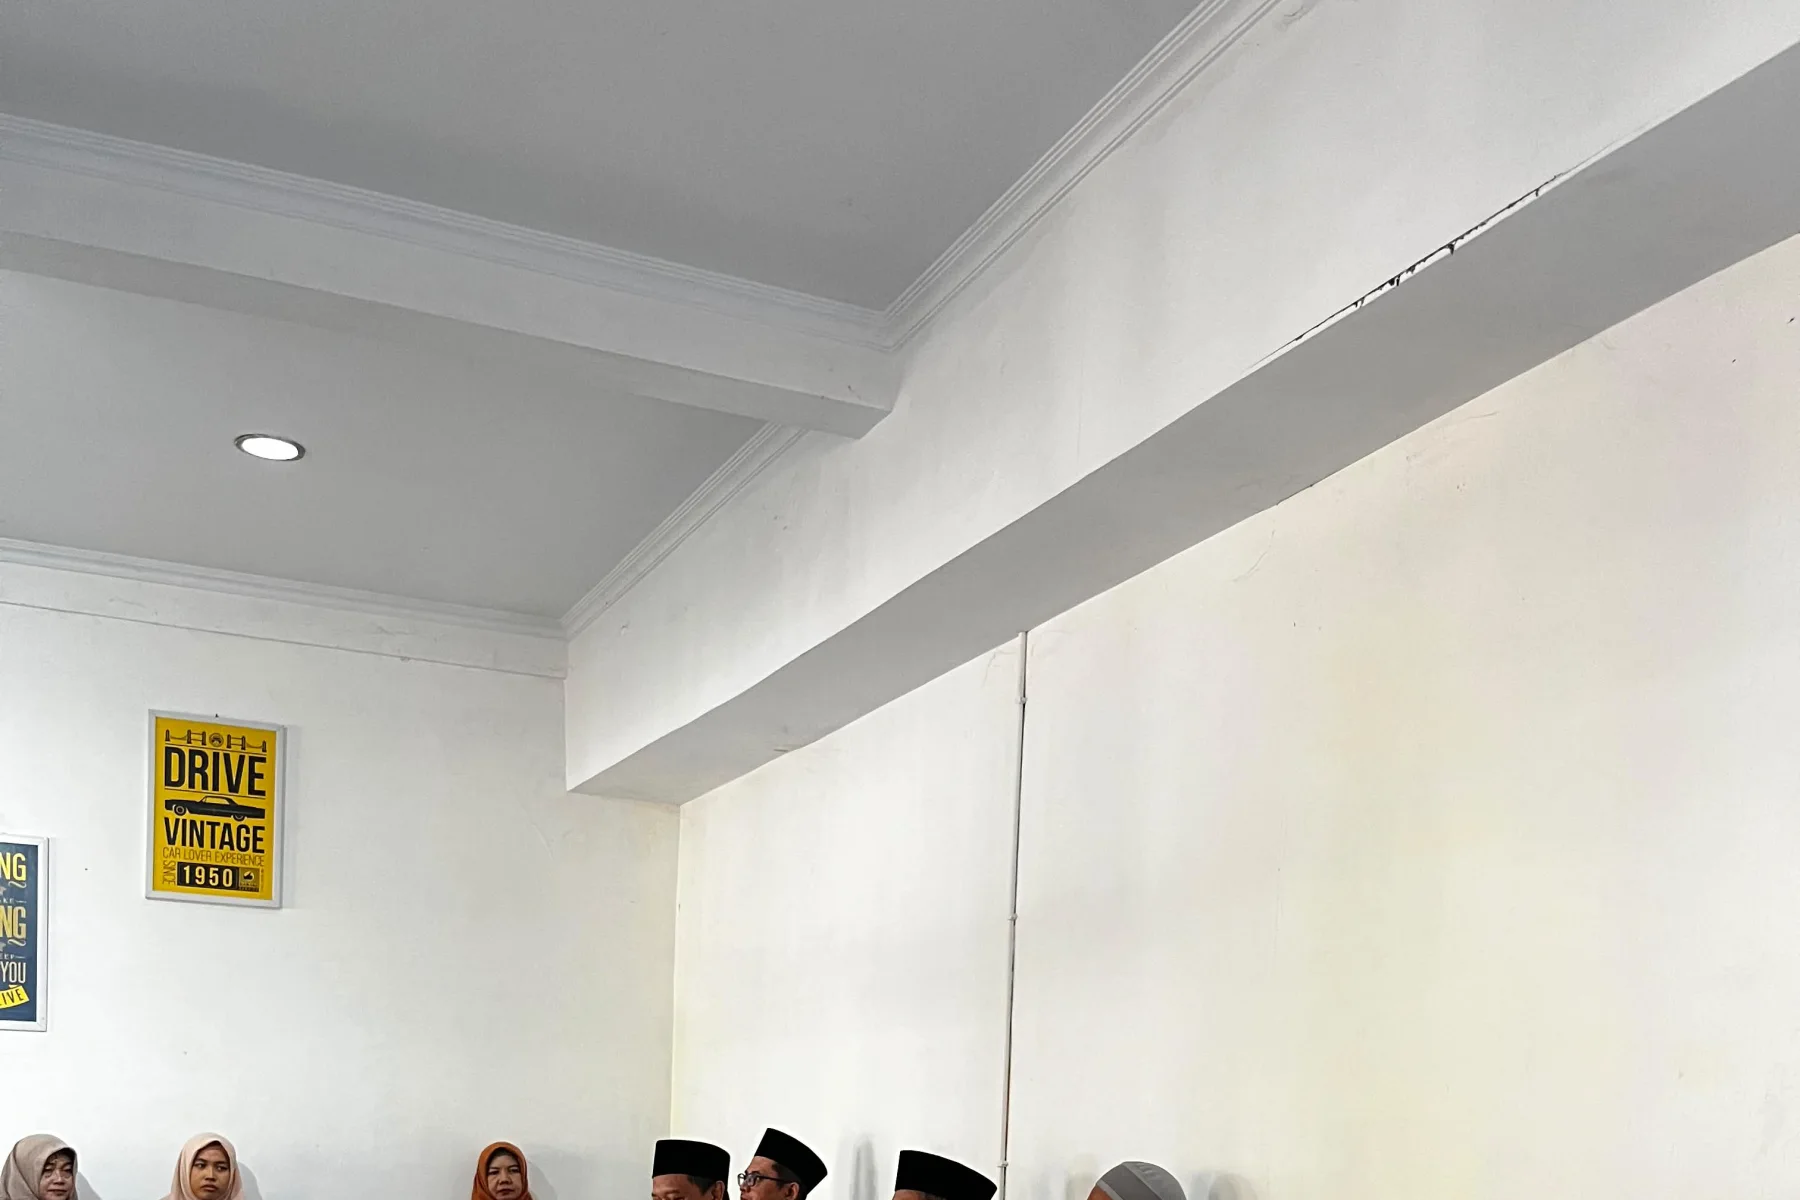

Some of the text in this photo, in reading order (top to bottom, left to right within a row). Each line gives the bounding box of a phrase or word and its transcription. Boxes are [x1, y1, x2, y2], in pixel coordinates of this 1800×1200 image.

[165, 747, 266, 796] DRIVE
[165, 817, 265, 853] VINTAGE
[163, 847, 264, 867] CAR LOVER EXPERIENCE
[163, 860, 176, 885] SINCE
[183, 865, 233, 887] 1950
[0, 961, 26, 983] YOU
[0, 989, 24, 1006] IVE
